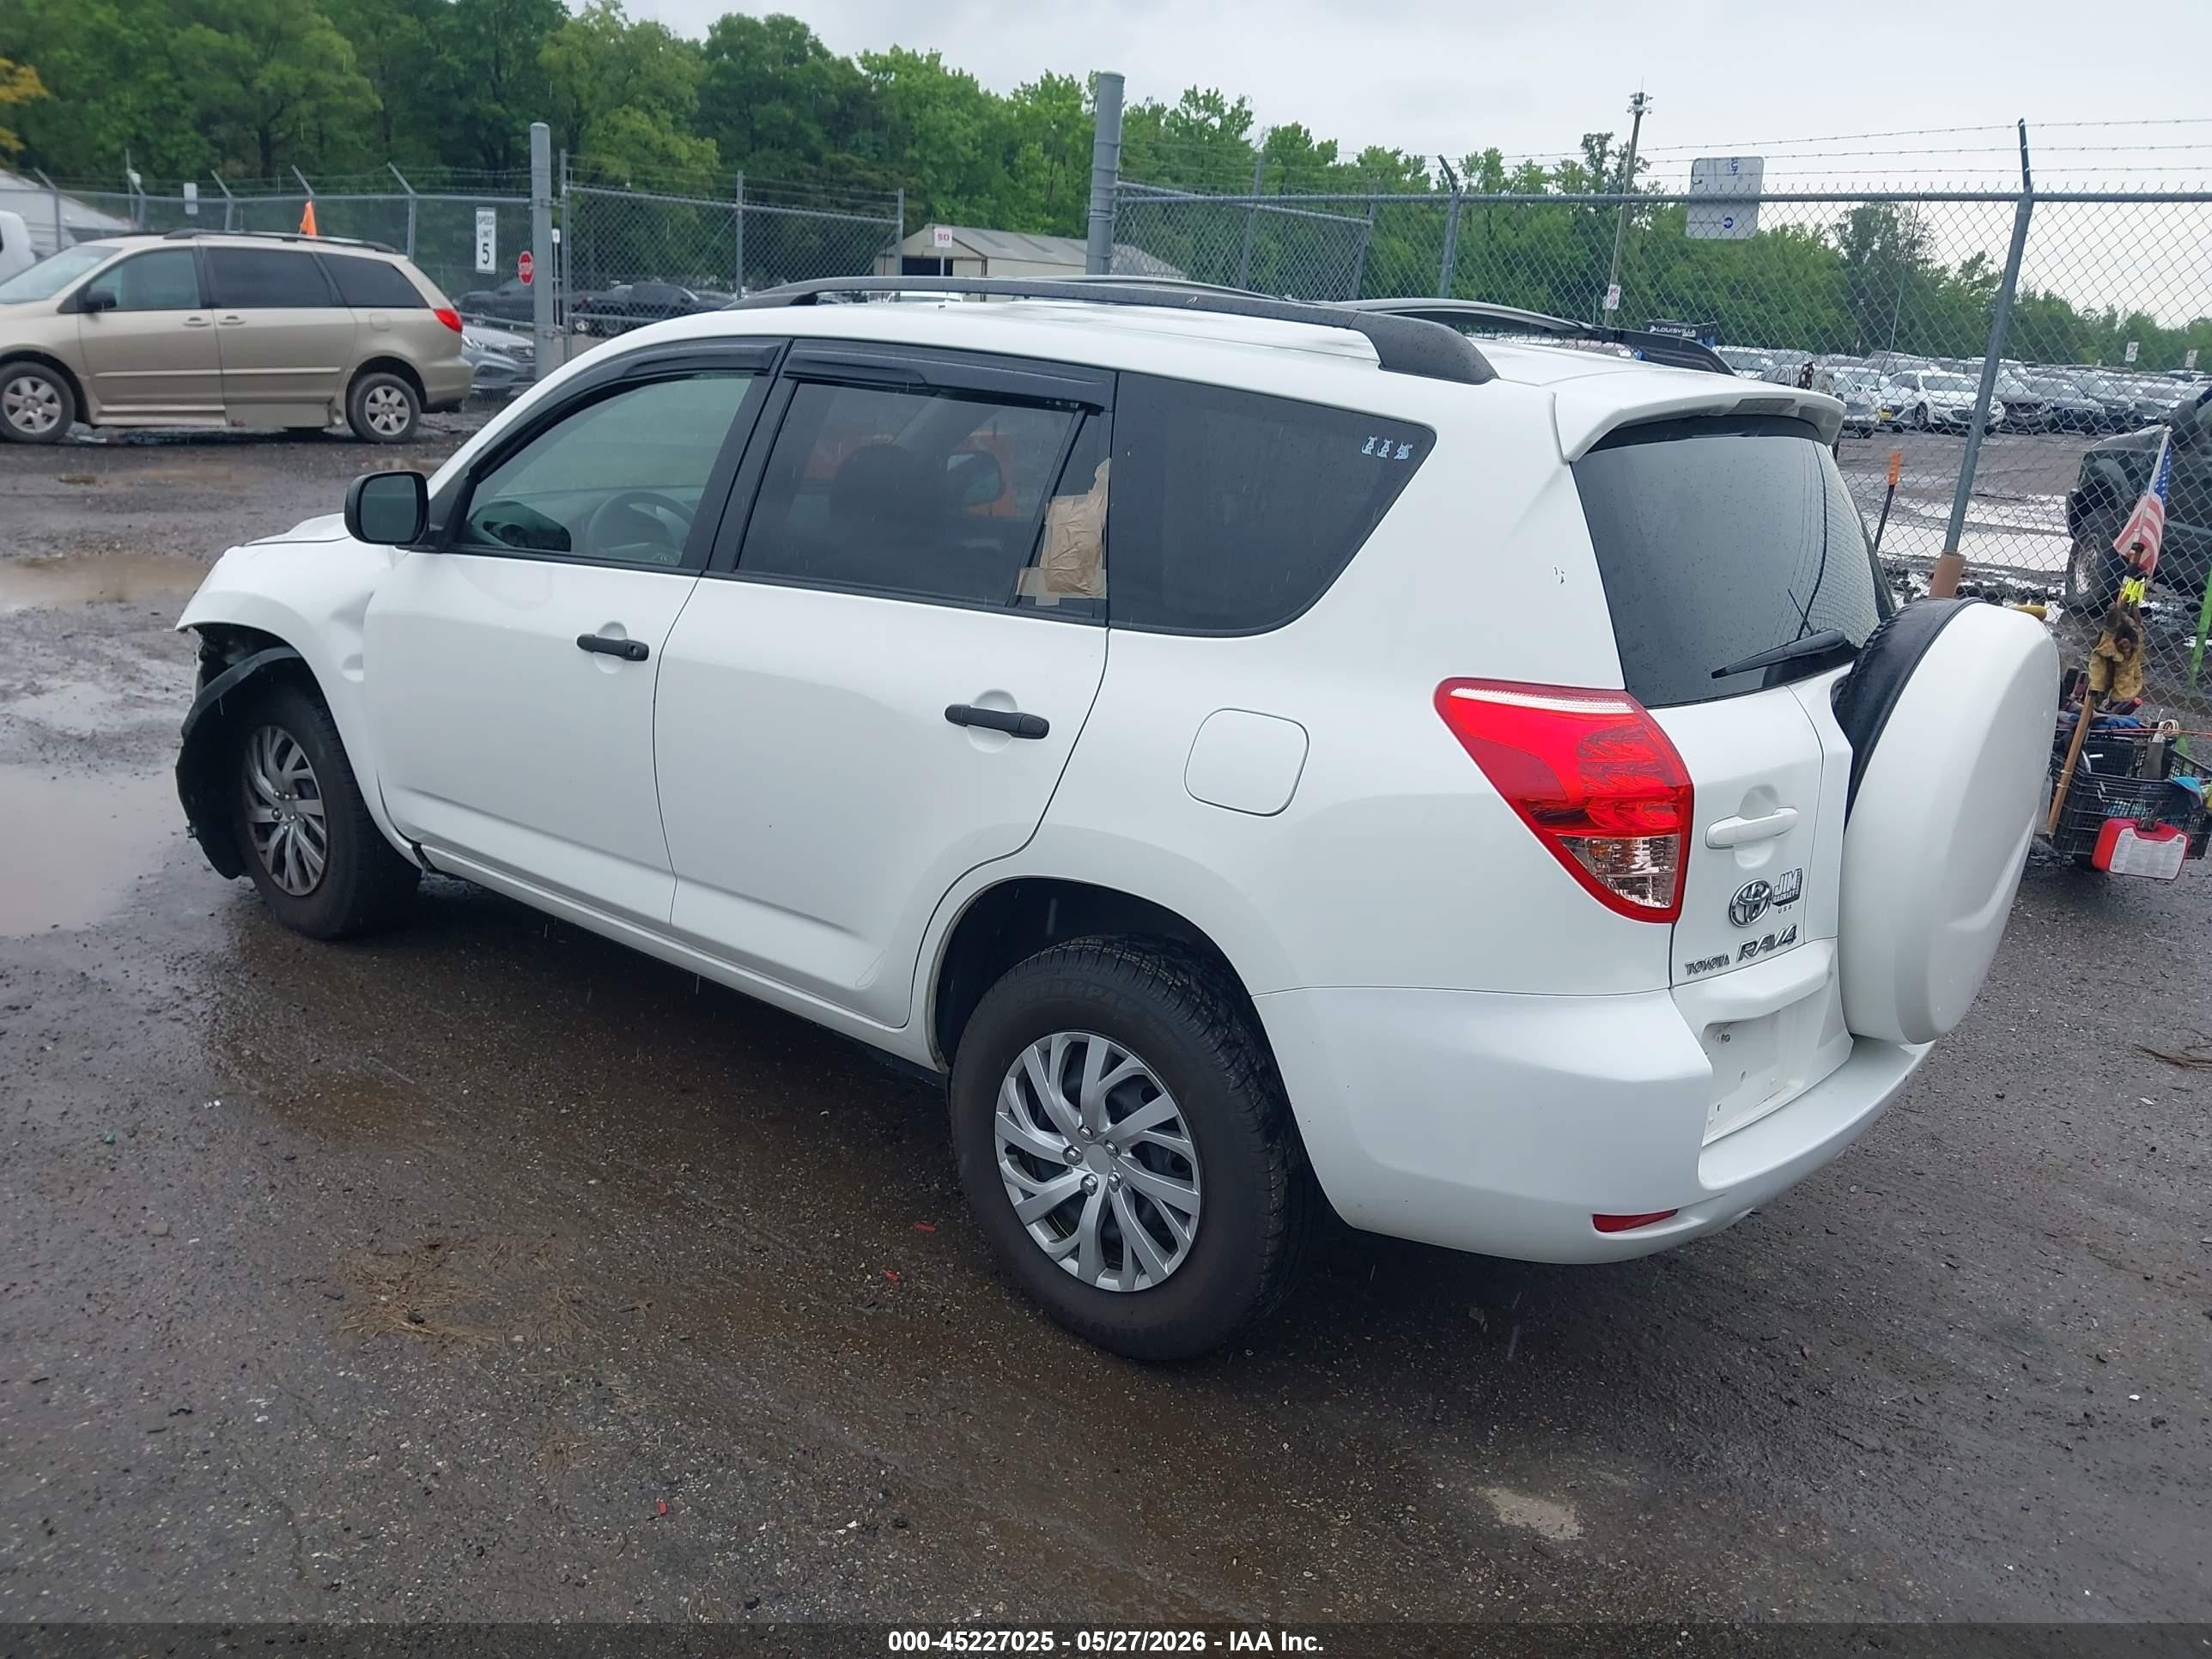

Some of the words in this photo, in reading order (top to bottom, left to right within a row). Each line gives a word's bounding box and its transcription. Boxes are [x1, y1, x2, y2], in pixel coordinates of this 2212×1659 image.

[482, 242, 490, 264] 5
[1773, 867, 1799, 896] JIM
[1778, 903, 1792, 915] USA
[1684, 953, 1730, 975] TOYOTA
[1735, 923, 1797, 963] RAV4
